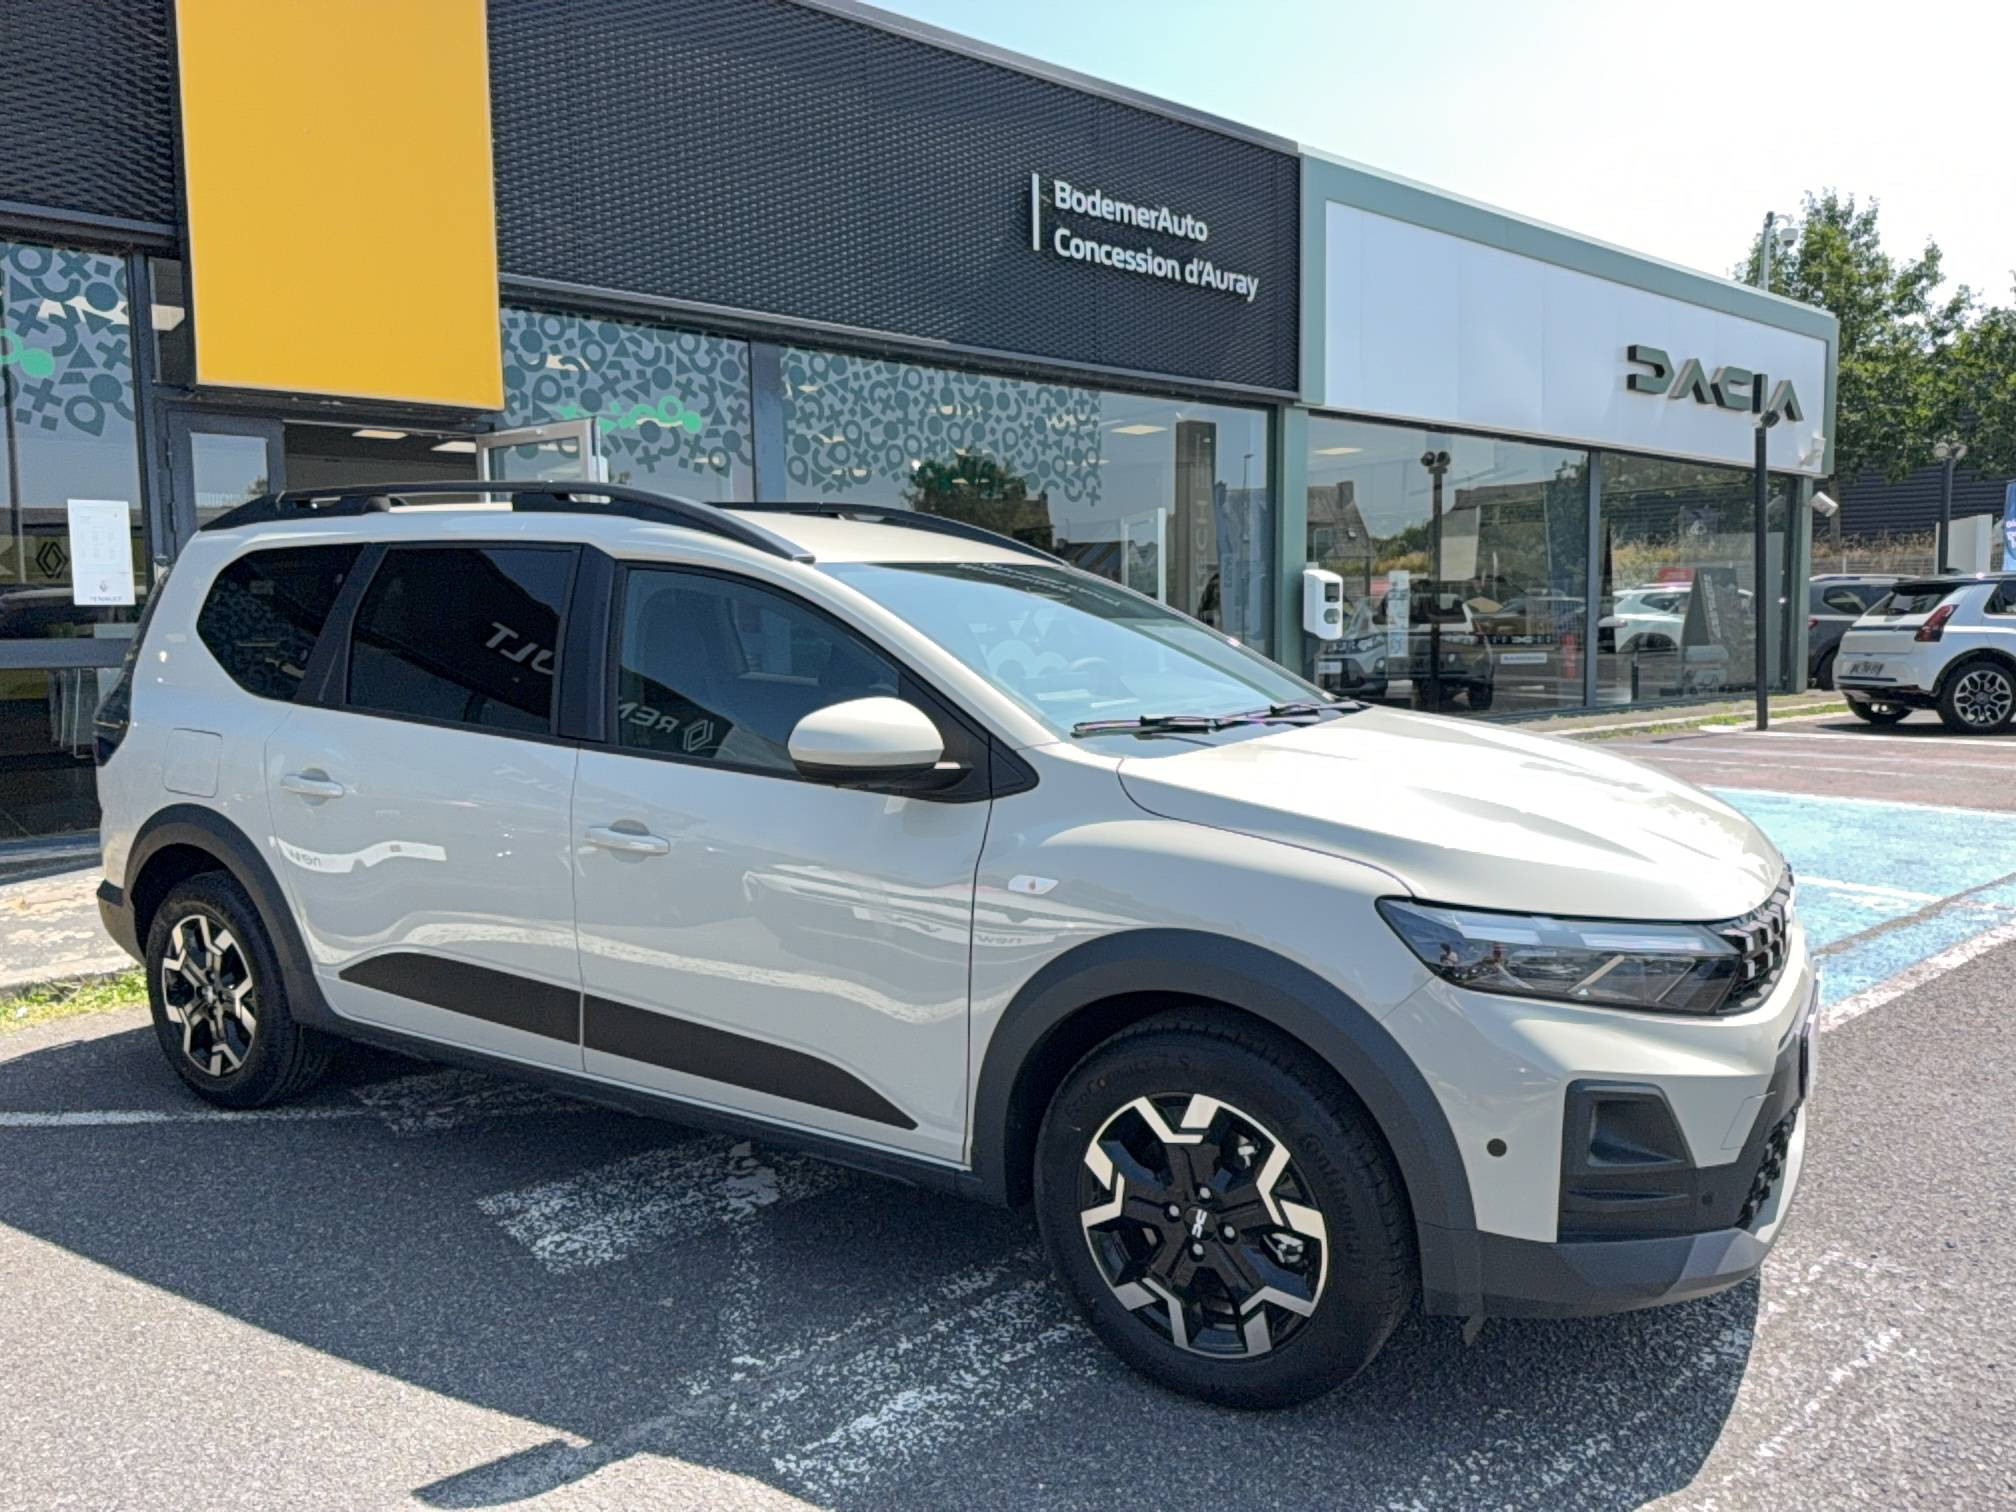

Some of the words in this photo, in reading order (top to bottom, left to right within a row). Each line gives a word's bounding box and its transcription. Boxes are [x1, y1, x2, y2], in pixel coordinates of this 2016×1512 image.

[1053, 179, 1208, 242] BodemerAuto
[1053, 227, 1181, 282] Concession
[1184, 257, 1259, 302] d'Auray
[1626, 344, 1804, 422] DACIA
